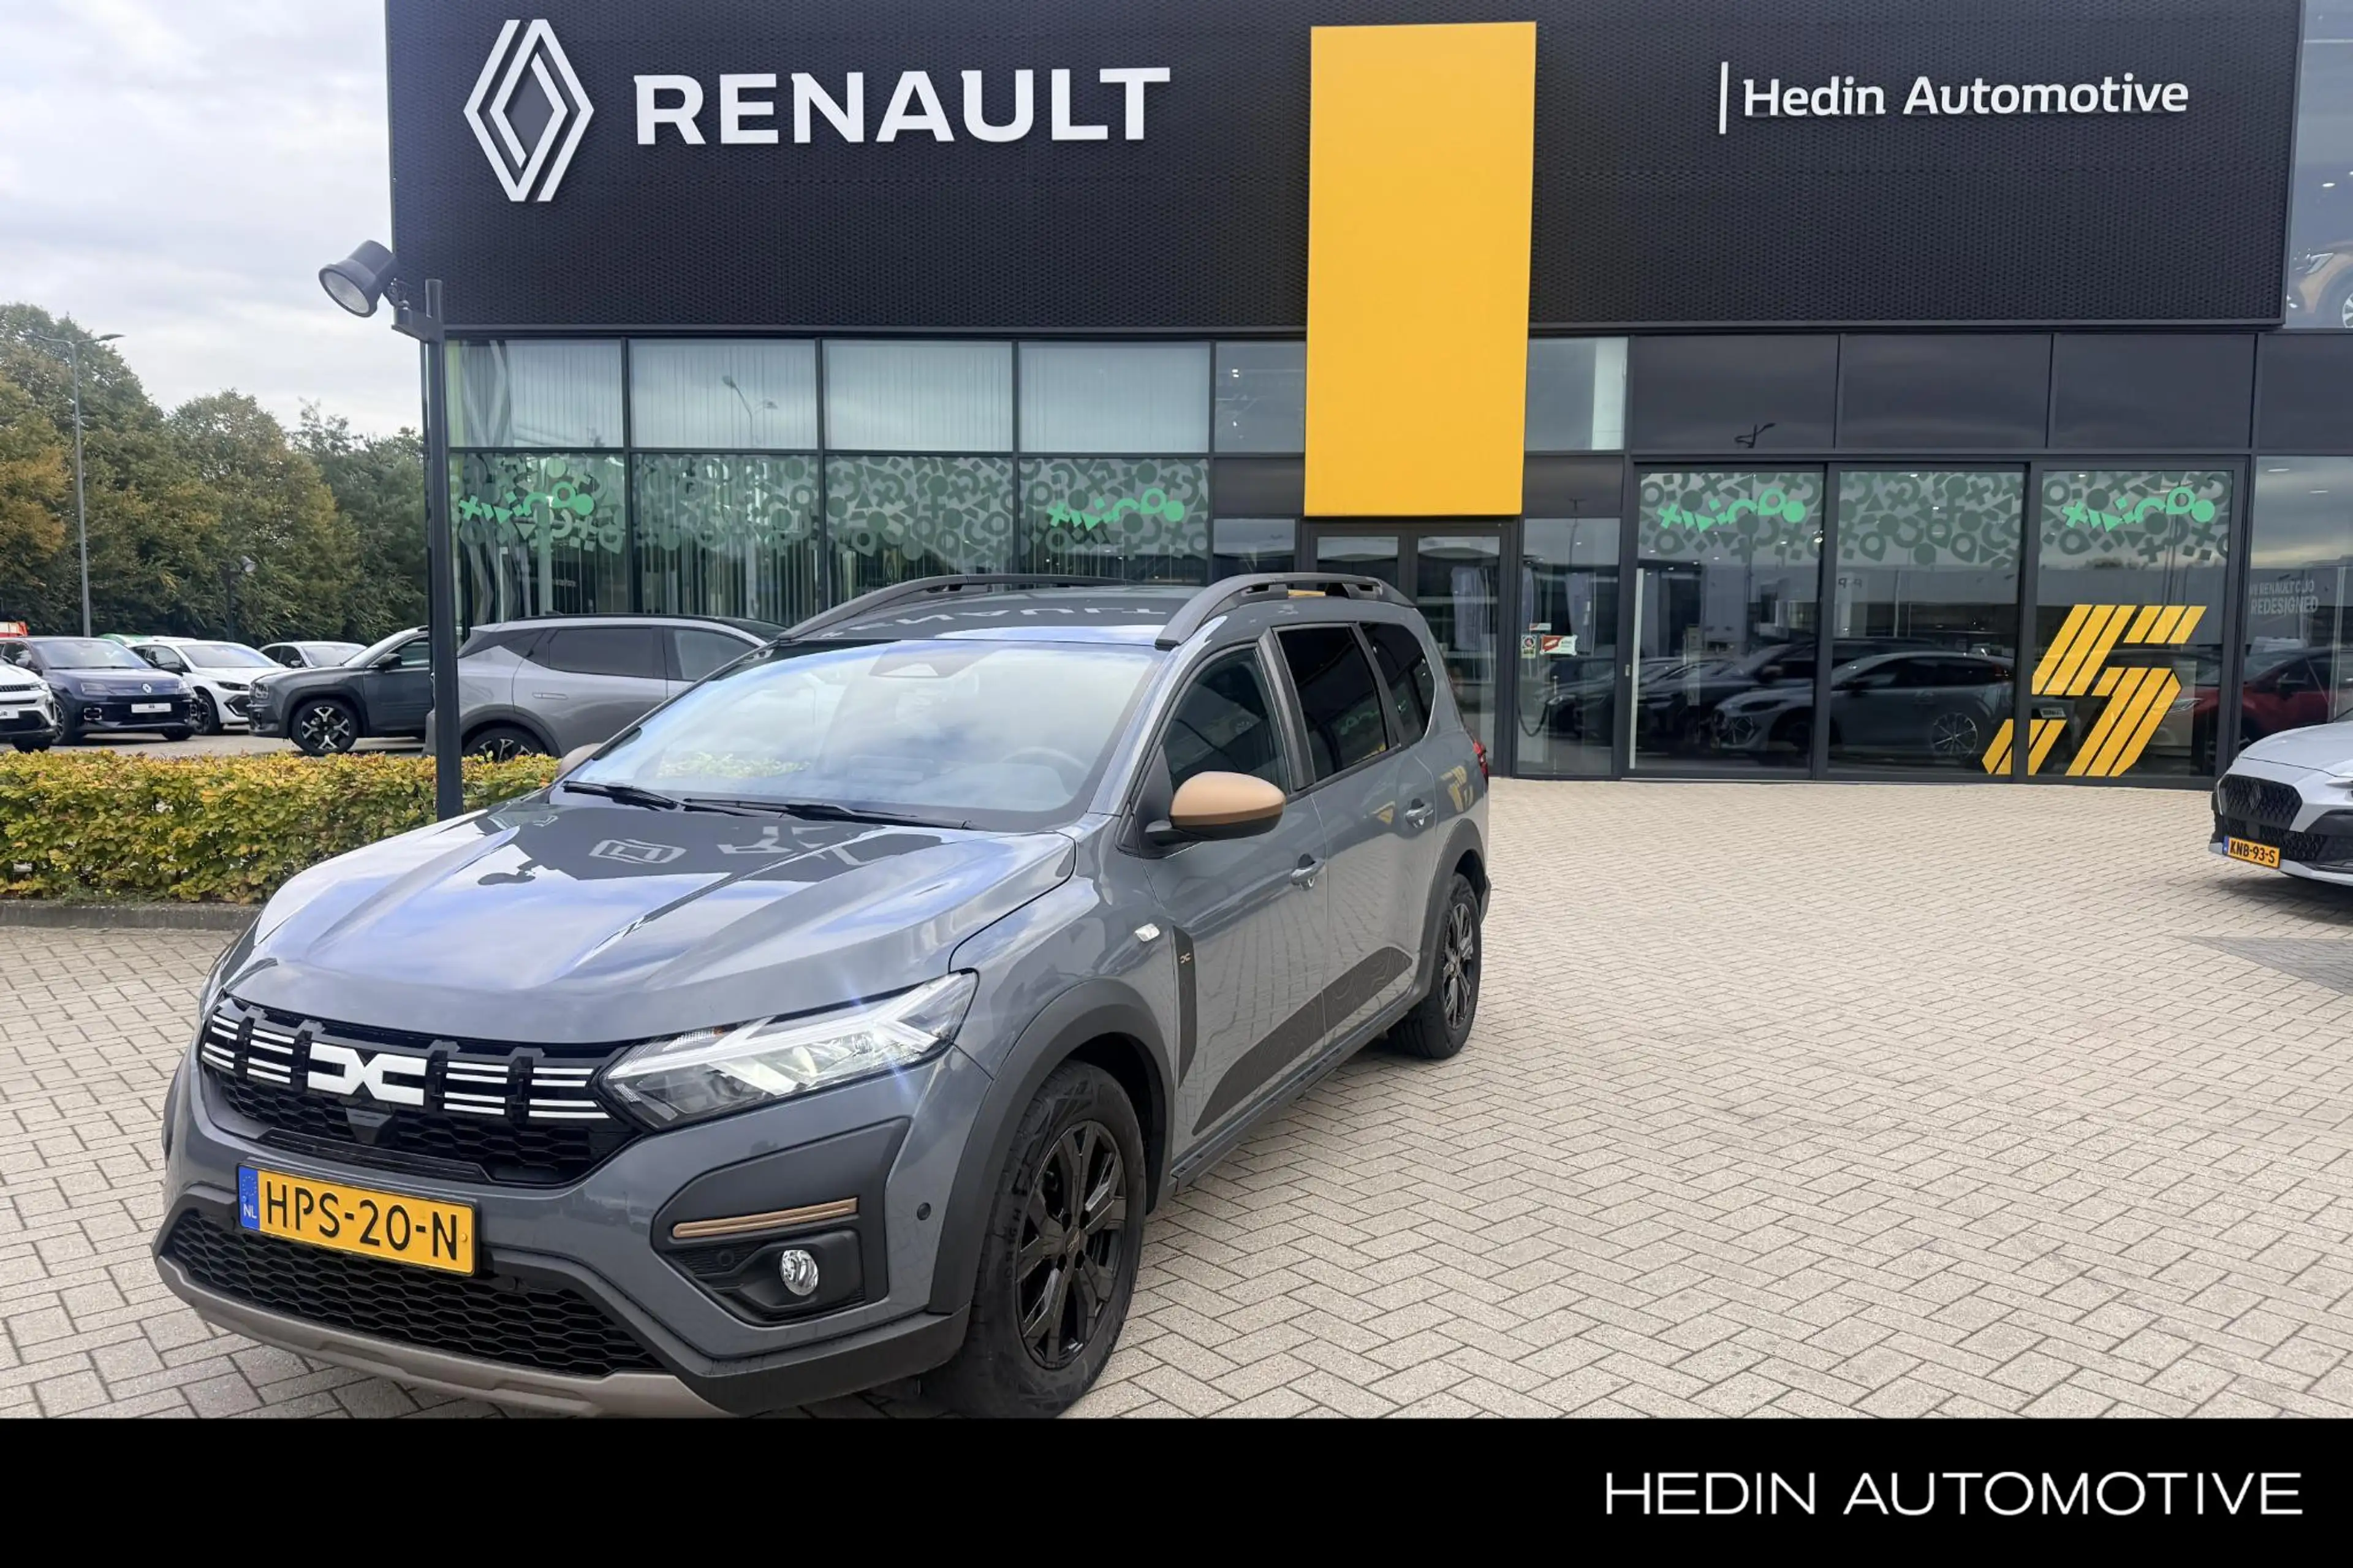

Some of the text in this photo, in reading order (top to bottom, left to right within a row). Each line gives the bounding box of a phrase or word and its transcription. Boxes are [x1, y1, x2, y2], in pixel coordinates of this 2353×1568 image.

[634, 67, 1170, 145] RENAULT
[1743, 72, 2189, 116] Hedin Automotive
[2230, 839, 2275, 864] KNB-93-S
[243, 1203, 257, 1219] NL
[267, 1180, 457, 1260] HPS-20-N
